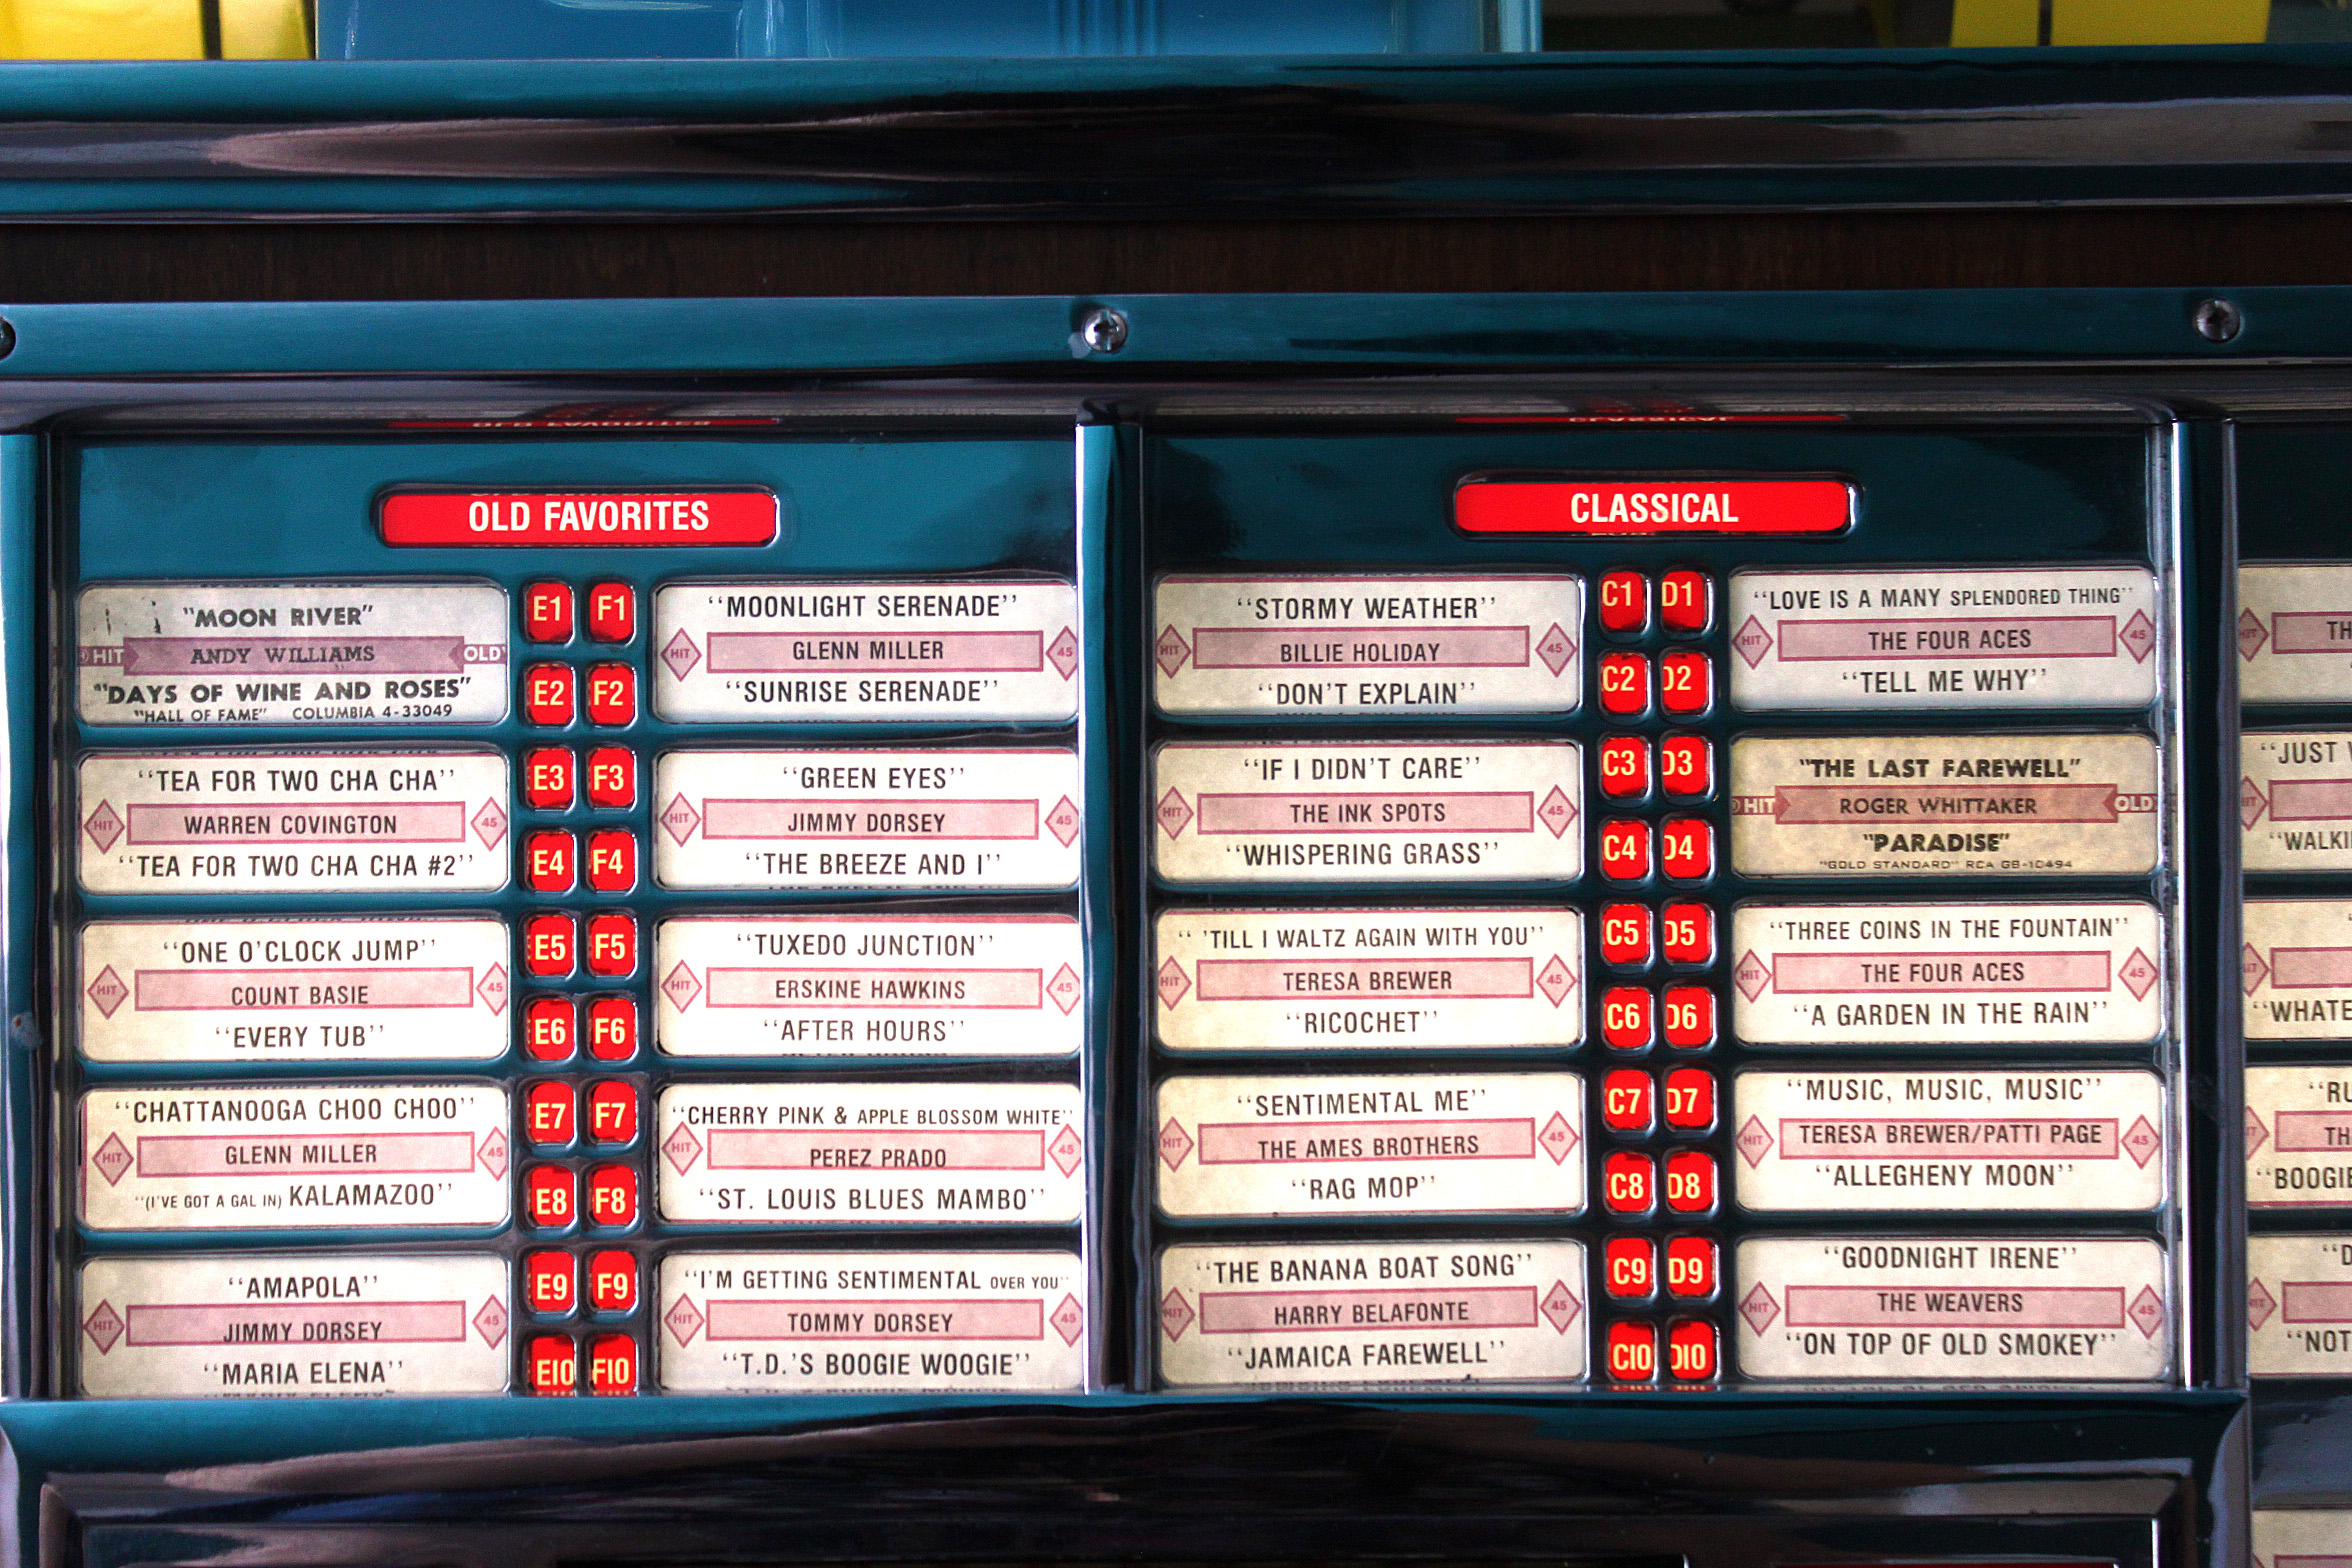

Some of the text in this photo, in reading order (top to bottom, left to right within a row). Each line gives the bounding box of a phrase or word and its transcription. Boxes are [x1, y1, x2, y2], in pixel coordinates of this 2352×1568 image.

[468, 500, 710, 533] OLD FAVORITES
[1570, 492, 1740, 524] CLASSICAL
[1602, 580, 1632, 607] C1
[1661, 581, 1692, 607] D1
[1829, 589, 1849, 609] IS
[1858, 589, 1872, 609] A
[1880, 588, 1941, 608] MANY
[1950, 588, 2062, 607] SPLENDORED
[533, 595, 561, 622] E1
[597, 594, 625, 621] F1
[1547, 642, 1563, 653] 45
[1867, 628, 2032, 651] THE FOUR ACES
[93, 648, 124, 664] HIT
[190, 644, 375, 665] ANDY WILLIAMS
[463, 645, 501, 661] OLD
[670, 647, 690, 659] HIT
[1057, 646, 1073, 657] 45
[1280, 643, 1440, 663] BILLIE HOLIDAY
[1602, 665, 1635, 692] C2
[189, 683, 223, 704] OF
[235, 682, 301, 702] WINE
[314, 681, 372, 701] AND
[533, 679, 565, 706] E2
[593, 680, 624, 706] F2
[190, 709, 212, 723] OF
[292, 703, 453, 720] COLUMBIA 4-33049
[1294, 758, 1300, 781] I
[1311, 757, 1391, 781] DIDN'T
[1602, 749, 1636, 777] C3
[1868, 758, 1930, 779] LAST
[211, 769, 256, 793] FOR
[266, 769, 318, 792] TWO
[330, 769, 379, 792] CHA
[533, 764, 565, 791] E3
[593, 764, 625, 791] F3
[1289, 802, 1446, 824] THE INK SPOTS
[1743, 797, 1775, 813] HIT
[1840, 796, 2038, 815] ROGER WHITTAKER
[2114, 795, 2153, 811] OLD
[183, 815, 397, 835] WARREN COVINGTON
[2269, 832, 2352, 851] "WALKI
[2001, 859, 2074, 870] GB-10494
[1605, 918, 1640, 946] C5
[1860, 919, 1921, 940] COINS
[1931, 920, 1951, 939] IN
[1960, 919, 2000, 939] THE
[775, 979, 965, 1000] ERSKINE HAWKINS
[1282, 970, 1452, 992] TERESA BREWER
[231, 985, 369, 1007] COUNT BASIE
[534, 1017, 567, 1045] E6
[594, 1017, 626, 1045] F6
[1608, 1087, 1642, 1115] C7
[1905, 1078, 1991, 1102] MUSIC,
[318, 1098, 382, 1121] CHOO
[778, 1106, 824, 1125] PINK
[834, 1106, 848, 1125] &
[857, 1109, 909, 1125] APPLE
[917, 1109, 998, 1125] BLOSSOM
[1799, 1124, 2102, 1145] TERESA BREWER/PATTI PAGE
[2132, 1134, 2149, 1145] 45
[102, 1151, 122, 1163] HIT
[225, 1144, 377, 1166] GLENN MILLER
[810, 1148, 947, 1169] PEREZ PRADO
[1257, 1135, 1479, 1161] THE AMES BROTHERS
[1667, 1172, 1701, 1200] D8
[183, 1195, 211, 1210] GOT
[215, 1194, 226, 1209] A
[230, 1194, 258, 1209] GAL
[262, 1194, 283, 1211] IN)
[535, 1187, 568, 1216] E8
[595, 1187, 627, 1215] F8
[767, 1188, 836, 1211] LOUIS
[848, 1188, 924, 1211] BLUES
[742, 1270, 828, 1290] GETTING
[837, 1270, 981, 1290] SENTIMENTAL
[990, 1276, 1025, 1290] OVER
[1613, 1257, 1646, 1285] C9
[1668, 1257, 1704, 1284] D9
[536, 1273, 568, 1301] E9
[597, 1272, 629, 1300] F9
[1274, 1301, 1470, 1326] HARRY BELAFONTE
[1748, 1302, 1769, 1312] HIT
[1877, 1292, 2023, 1313] THE WEAVERS
[222, 1321, 382, 1344] JIMMY DORSEY
[787, 1313, 953, 1333] TOMMY DORSEY
[1846, 1332, 1892, 1356] TOP
[1901, 1332, 1932, 1356] OF
[1942, 1332, 1988, 1356] OLD
